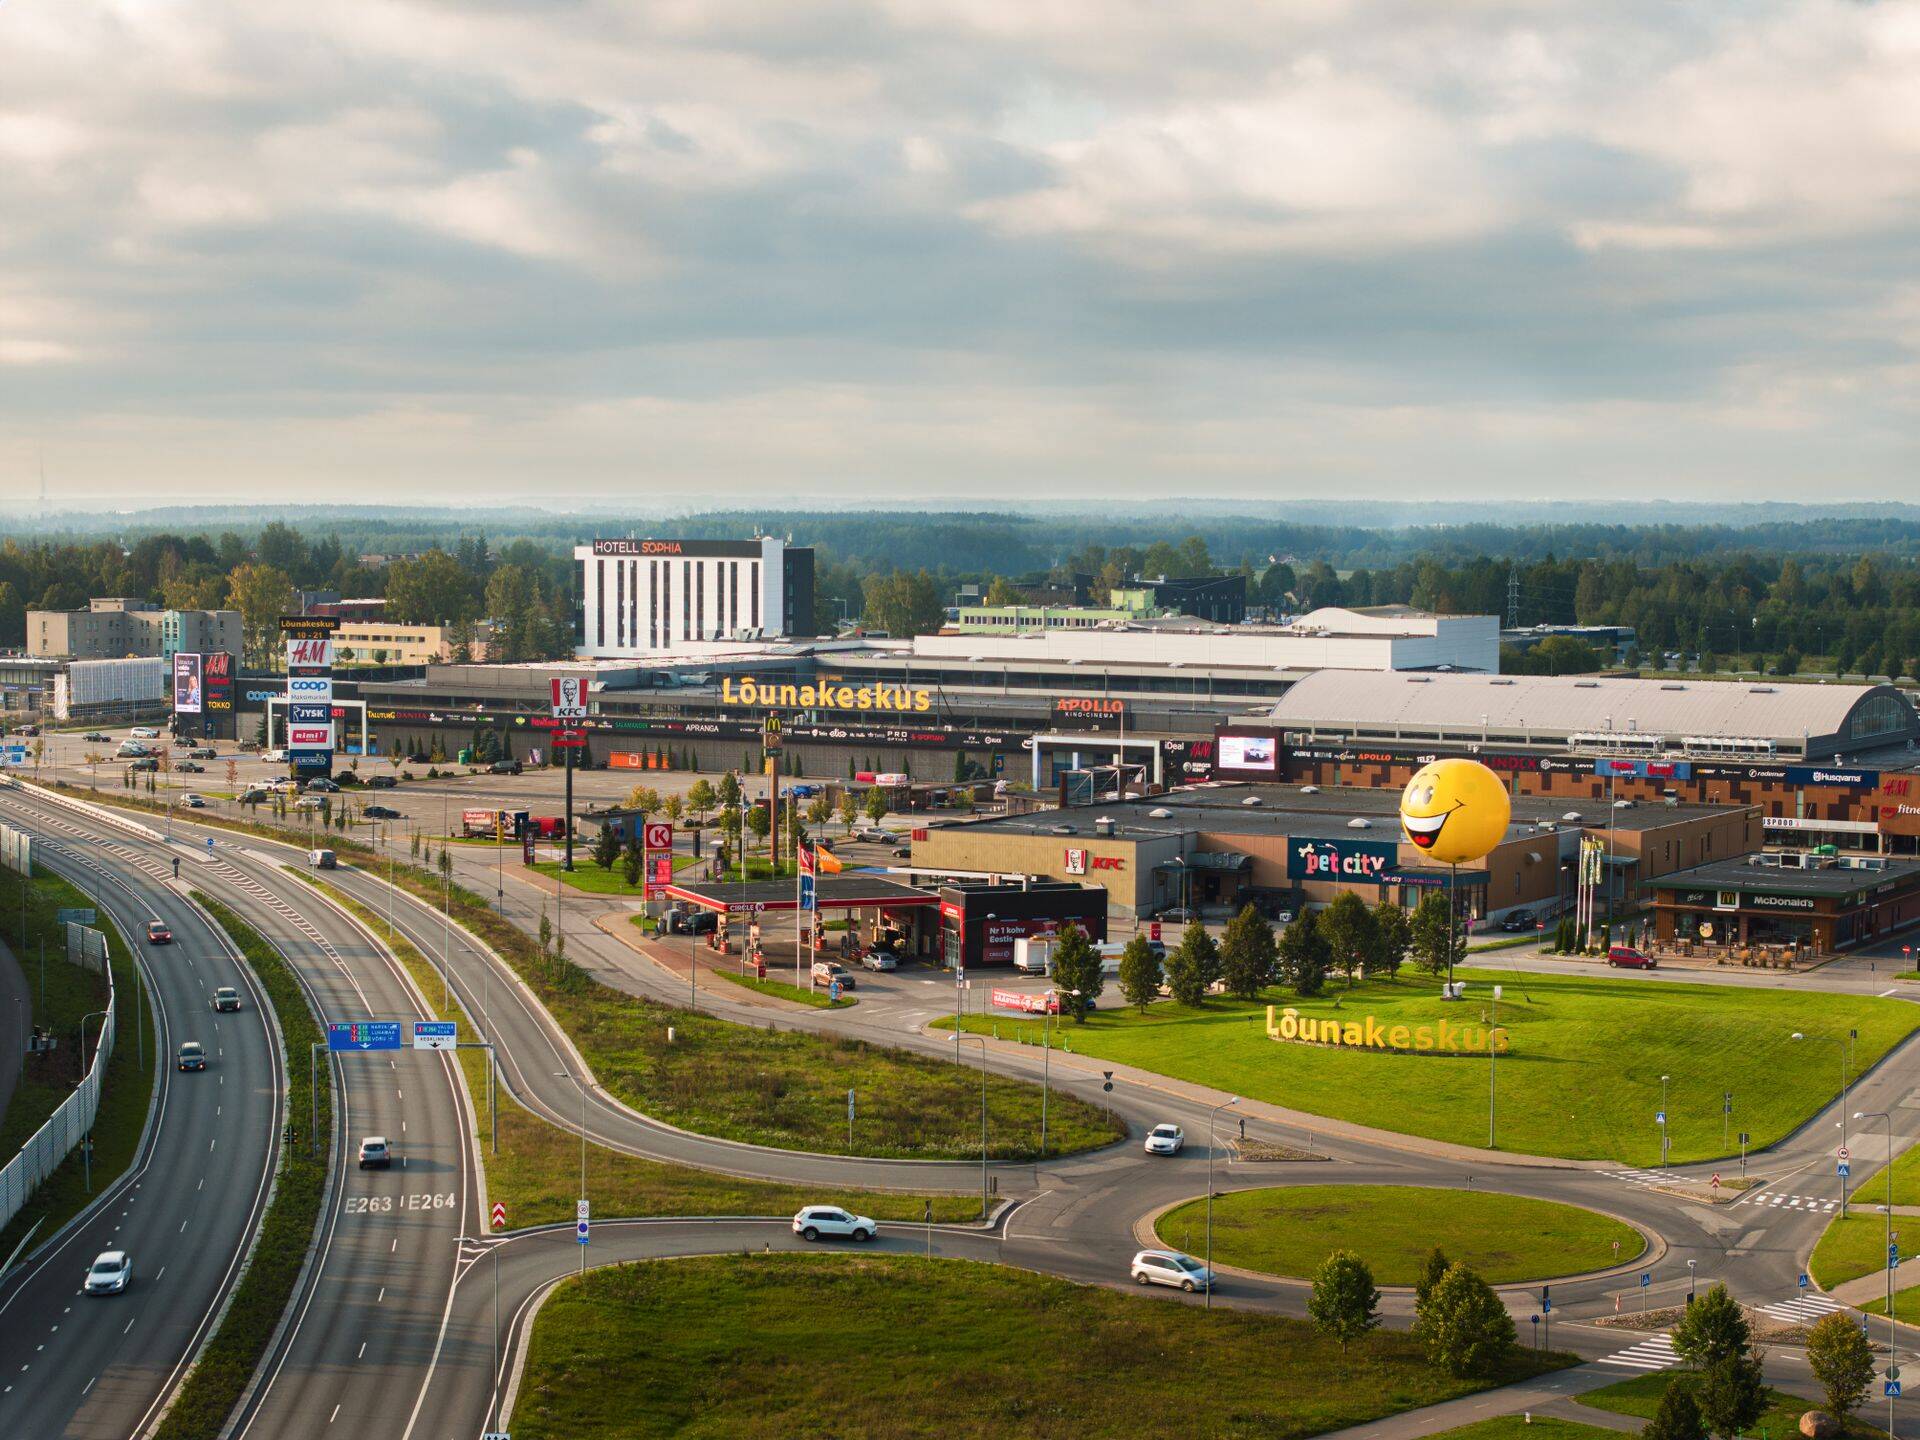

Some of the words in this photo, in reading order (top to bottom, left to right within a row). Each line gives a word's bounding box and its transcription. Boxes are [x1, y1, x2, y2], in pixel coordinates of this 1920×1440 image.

[596, 542, 639, 553] HOTELL
[642, 543, 682, 554] SOPHIA
[281, 619, 335, 629] Lõunakeskus
[292, 640, 326, 665] H&M
[722, 677, 932, 711] Lõunakeskus
[1056, 698, 1124, 713] APOLLO
[300, 709, 324, 718] JYSK
[558, 708, 582, 717] KFC
[685, 723, 720, 733] APRANGA
[1164, 740, 1185, 751] iDeal
[1358, 753, 1392, 761] APOLLO
[1821, 773, 1862, 783] Husqvarna
[1091, 857, 1126, 871] KFC
[1305, 852, 1339, 875] pet
[1343, 852, 1385, 877] city
[1753, 896, 1814, 908] McDonald's
[1006, 926, 1026, 934] kohv
[1266, 1004, 1510, 1053] Lõunakeskus
[345, 1196, 392, 1214] E263
[408, 1193, 457, 1211] E264
